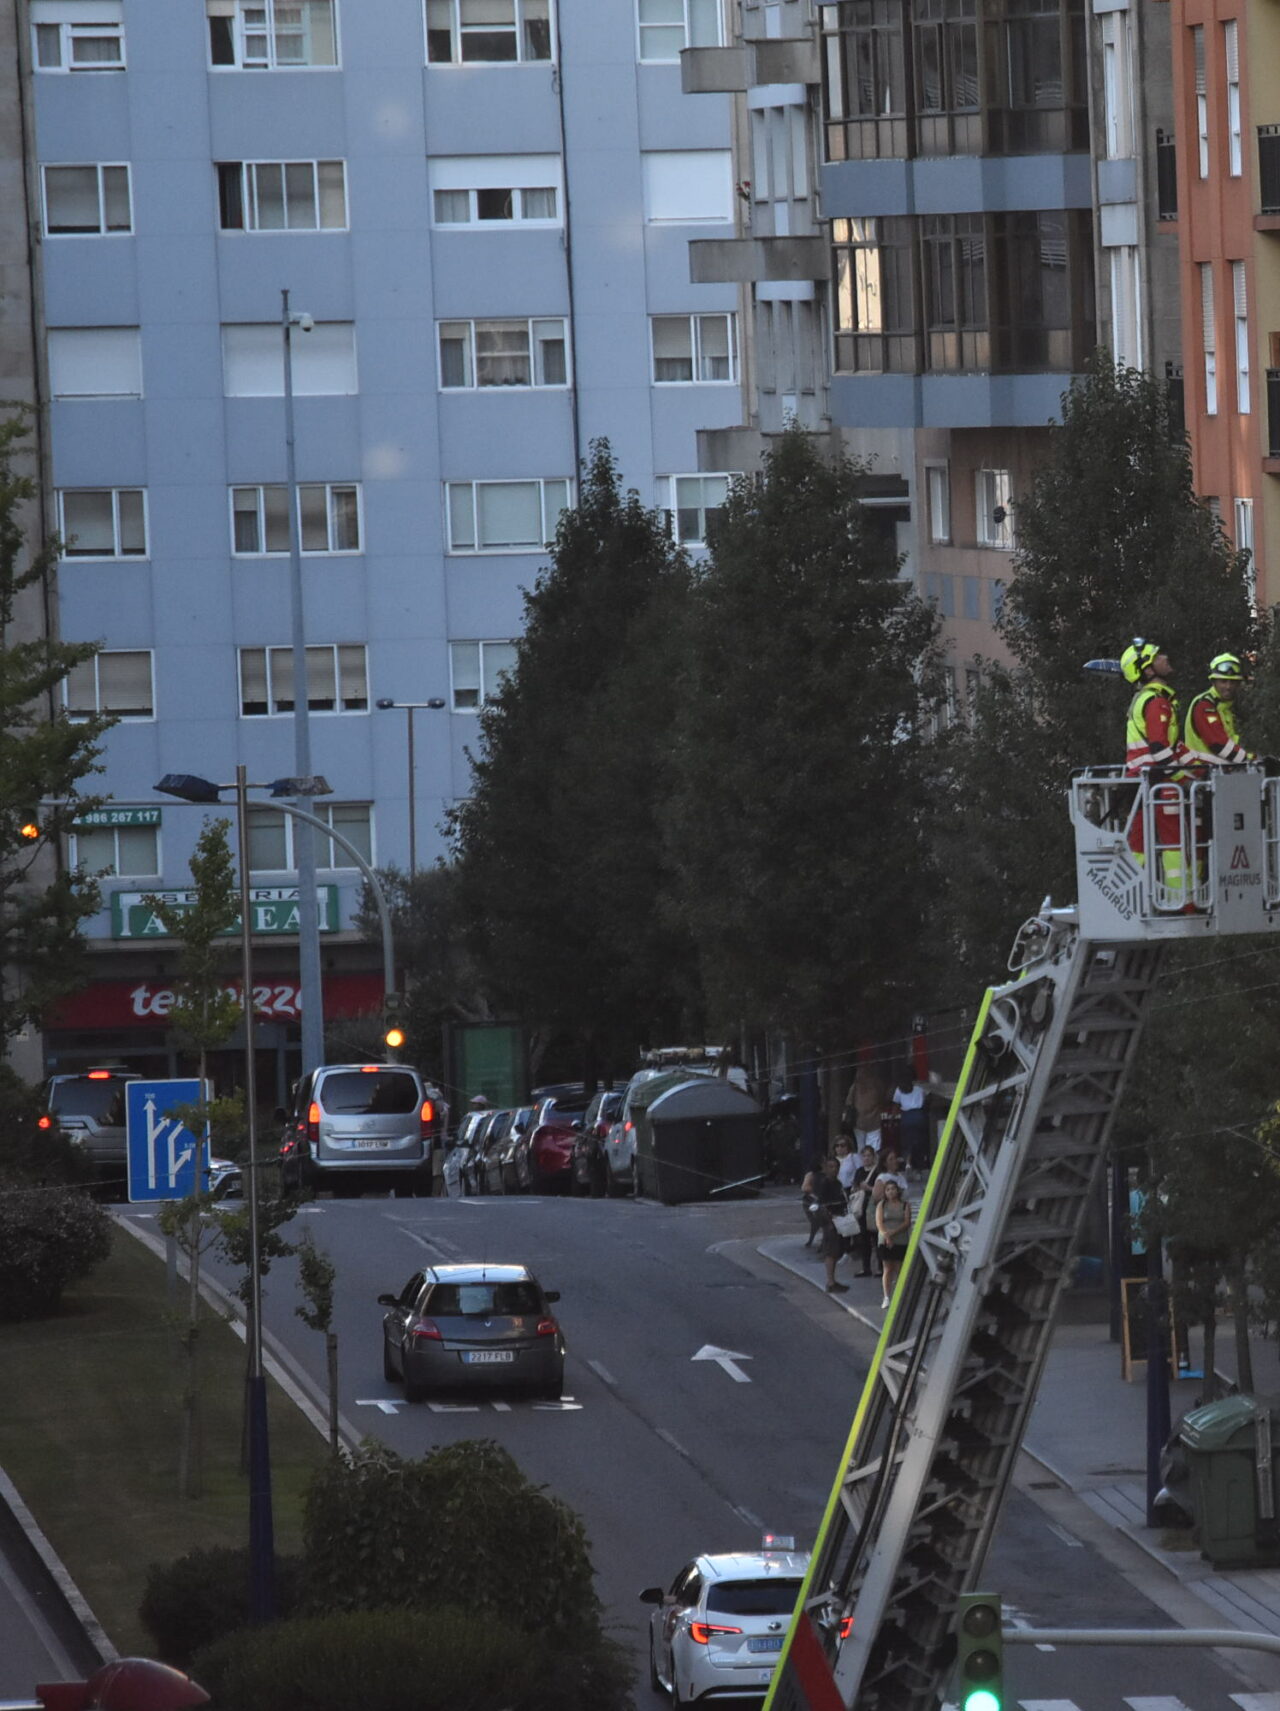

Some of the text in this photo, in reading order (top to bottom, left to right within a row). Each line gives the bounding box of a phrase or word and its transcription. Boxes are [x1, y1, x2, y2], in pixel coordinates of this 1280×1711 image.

[85, 811, 158, 824] 986 267 117
[1219, 873, 1261, 888] MAGIRUS
[1086, 868, 1133, 921] MAGIRUS
